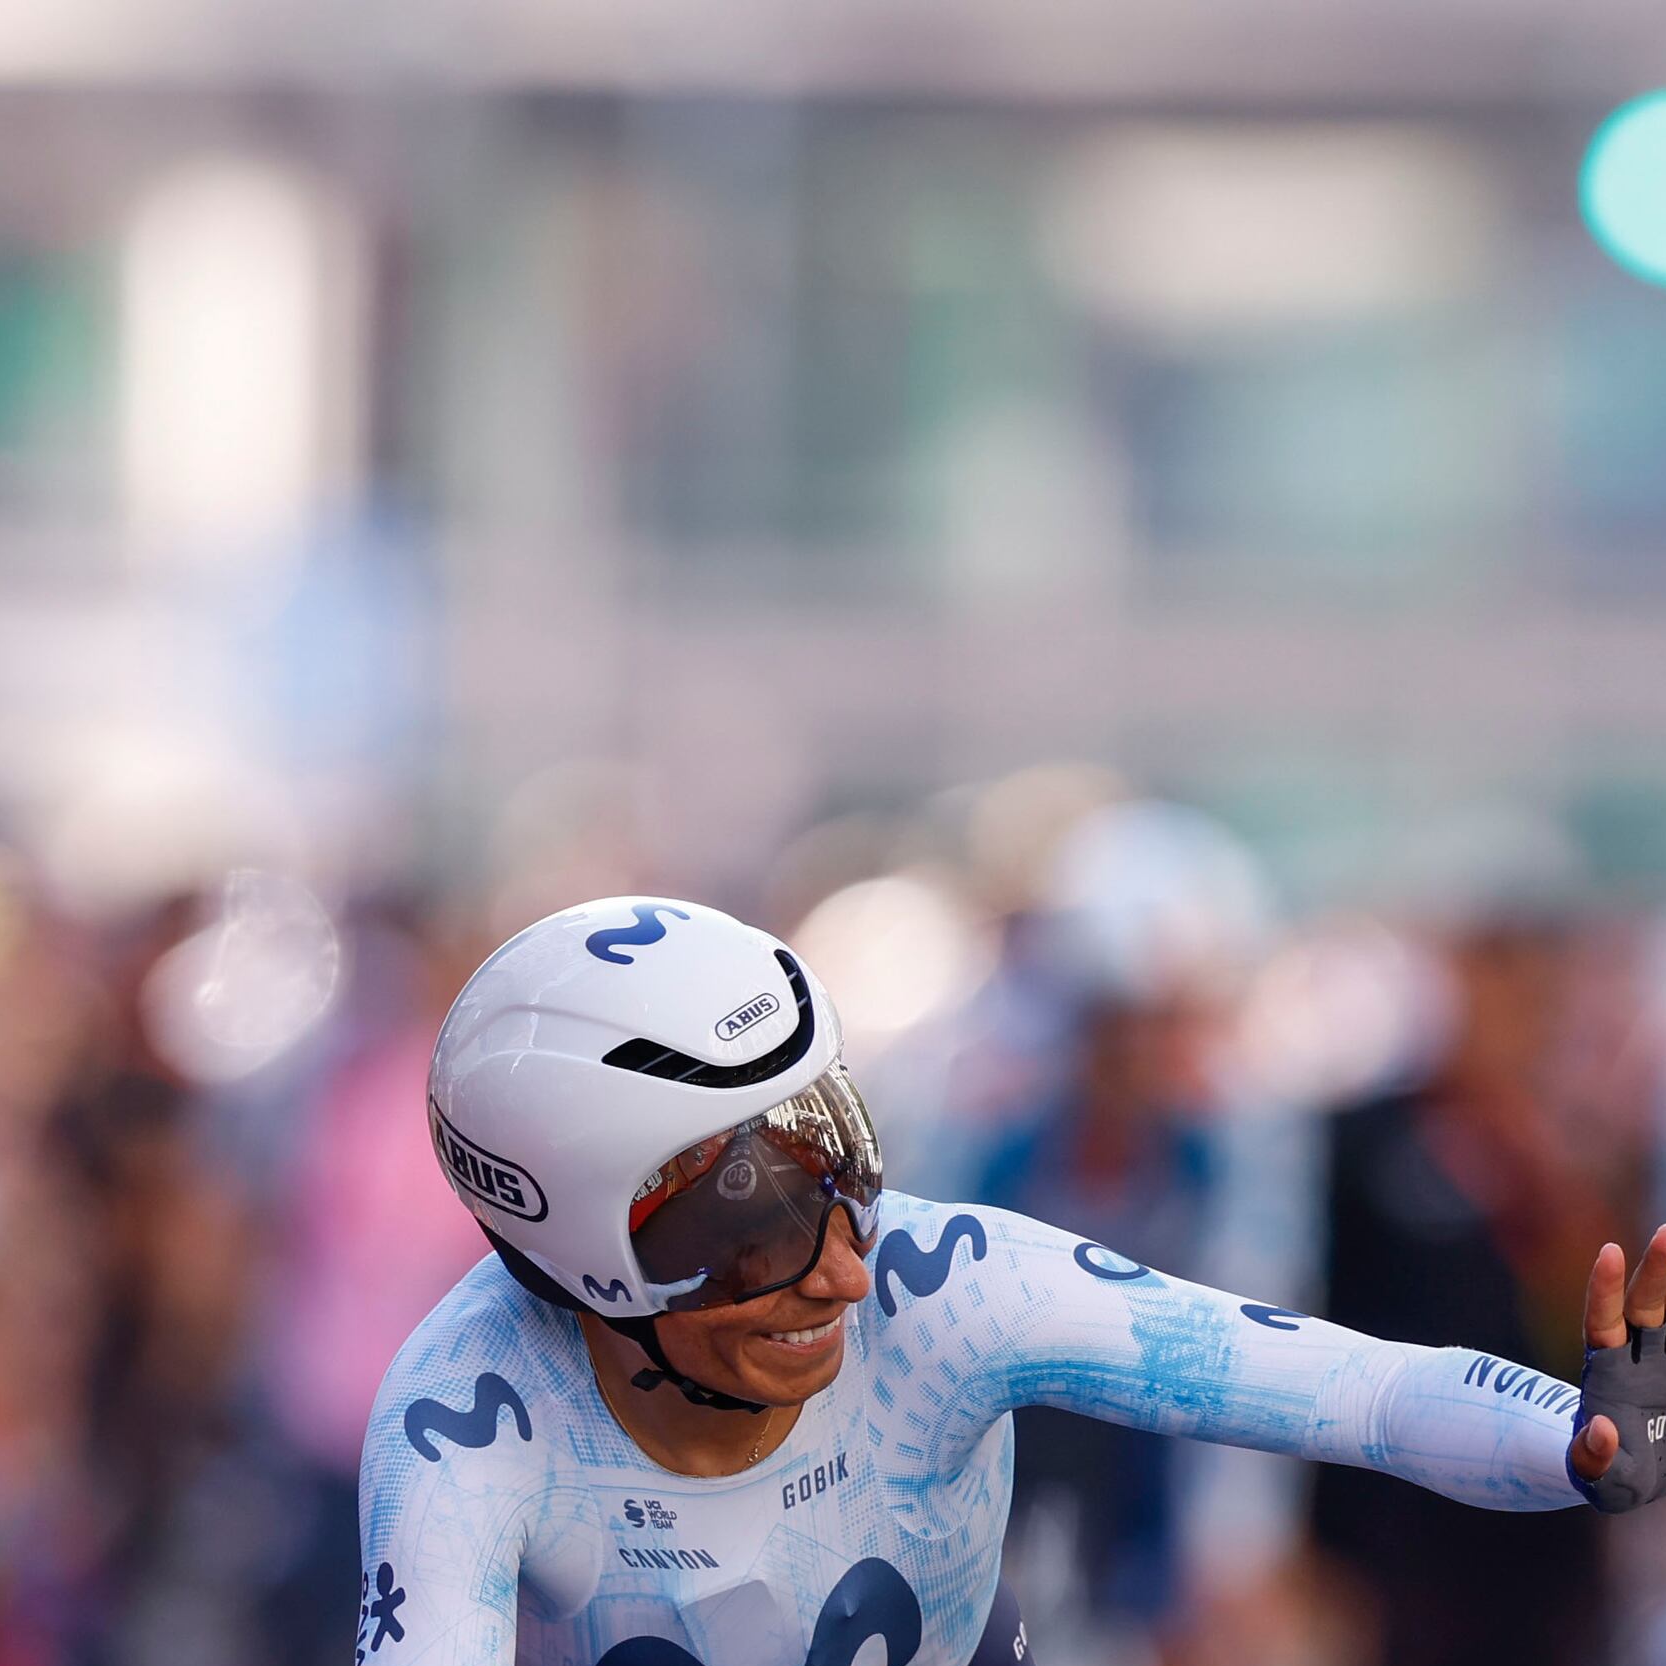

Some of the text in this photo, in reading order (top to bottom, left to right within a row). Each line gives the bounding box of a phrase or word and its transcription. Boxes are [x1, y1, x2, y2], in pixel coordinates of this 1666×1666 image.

[725, 998, 773, 1035] ABUS
[434, 1116, 526, 1209] ABUS
[782, 1451, 850, 1511] GOBIK
[647, 1509, 678, 1520] WORLD
[651, 1519, 674, 1530] TEAM
[618, 1548, 720, 1570] CANYON
